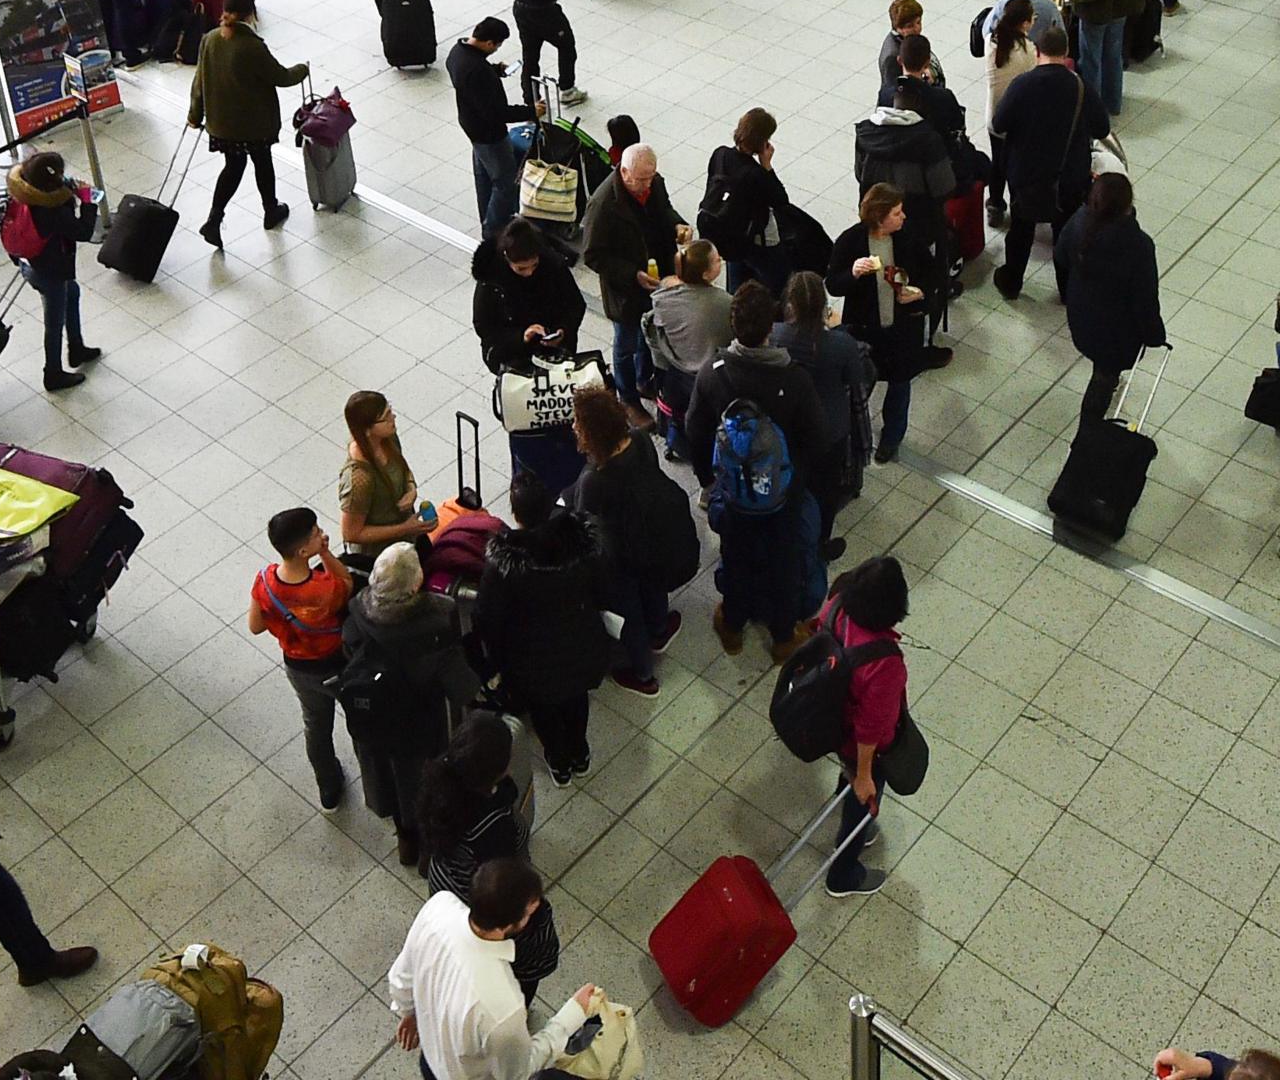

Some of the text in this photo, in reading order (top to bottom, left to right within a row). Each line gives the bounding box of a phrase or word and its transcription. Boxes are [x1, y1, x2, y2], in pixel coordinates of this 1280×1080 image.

[531, 382, 577, 399] STEVE
[526, 396, 574, 411] MADDE
[534, 410, 573, 422] STEV
